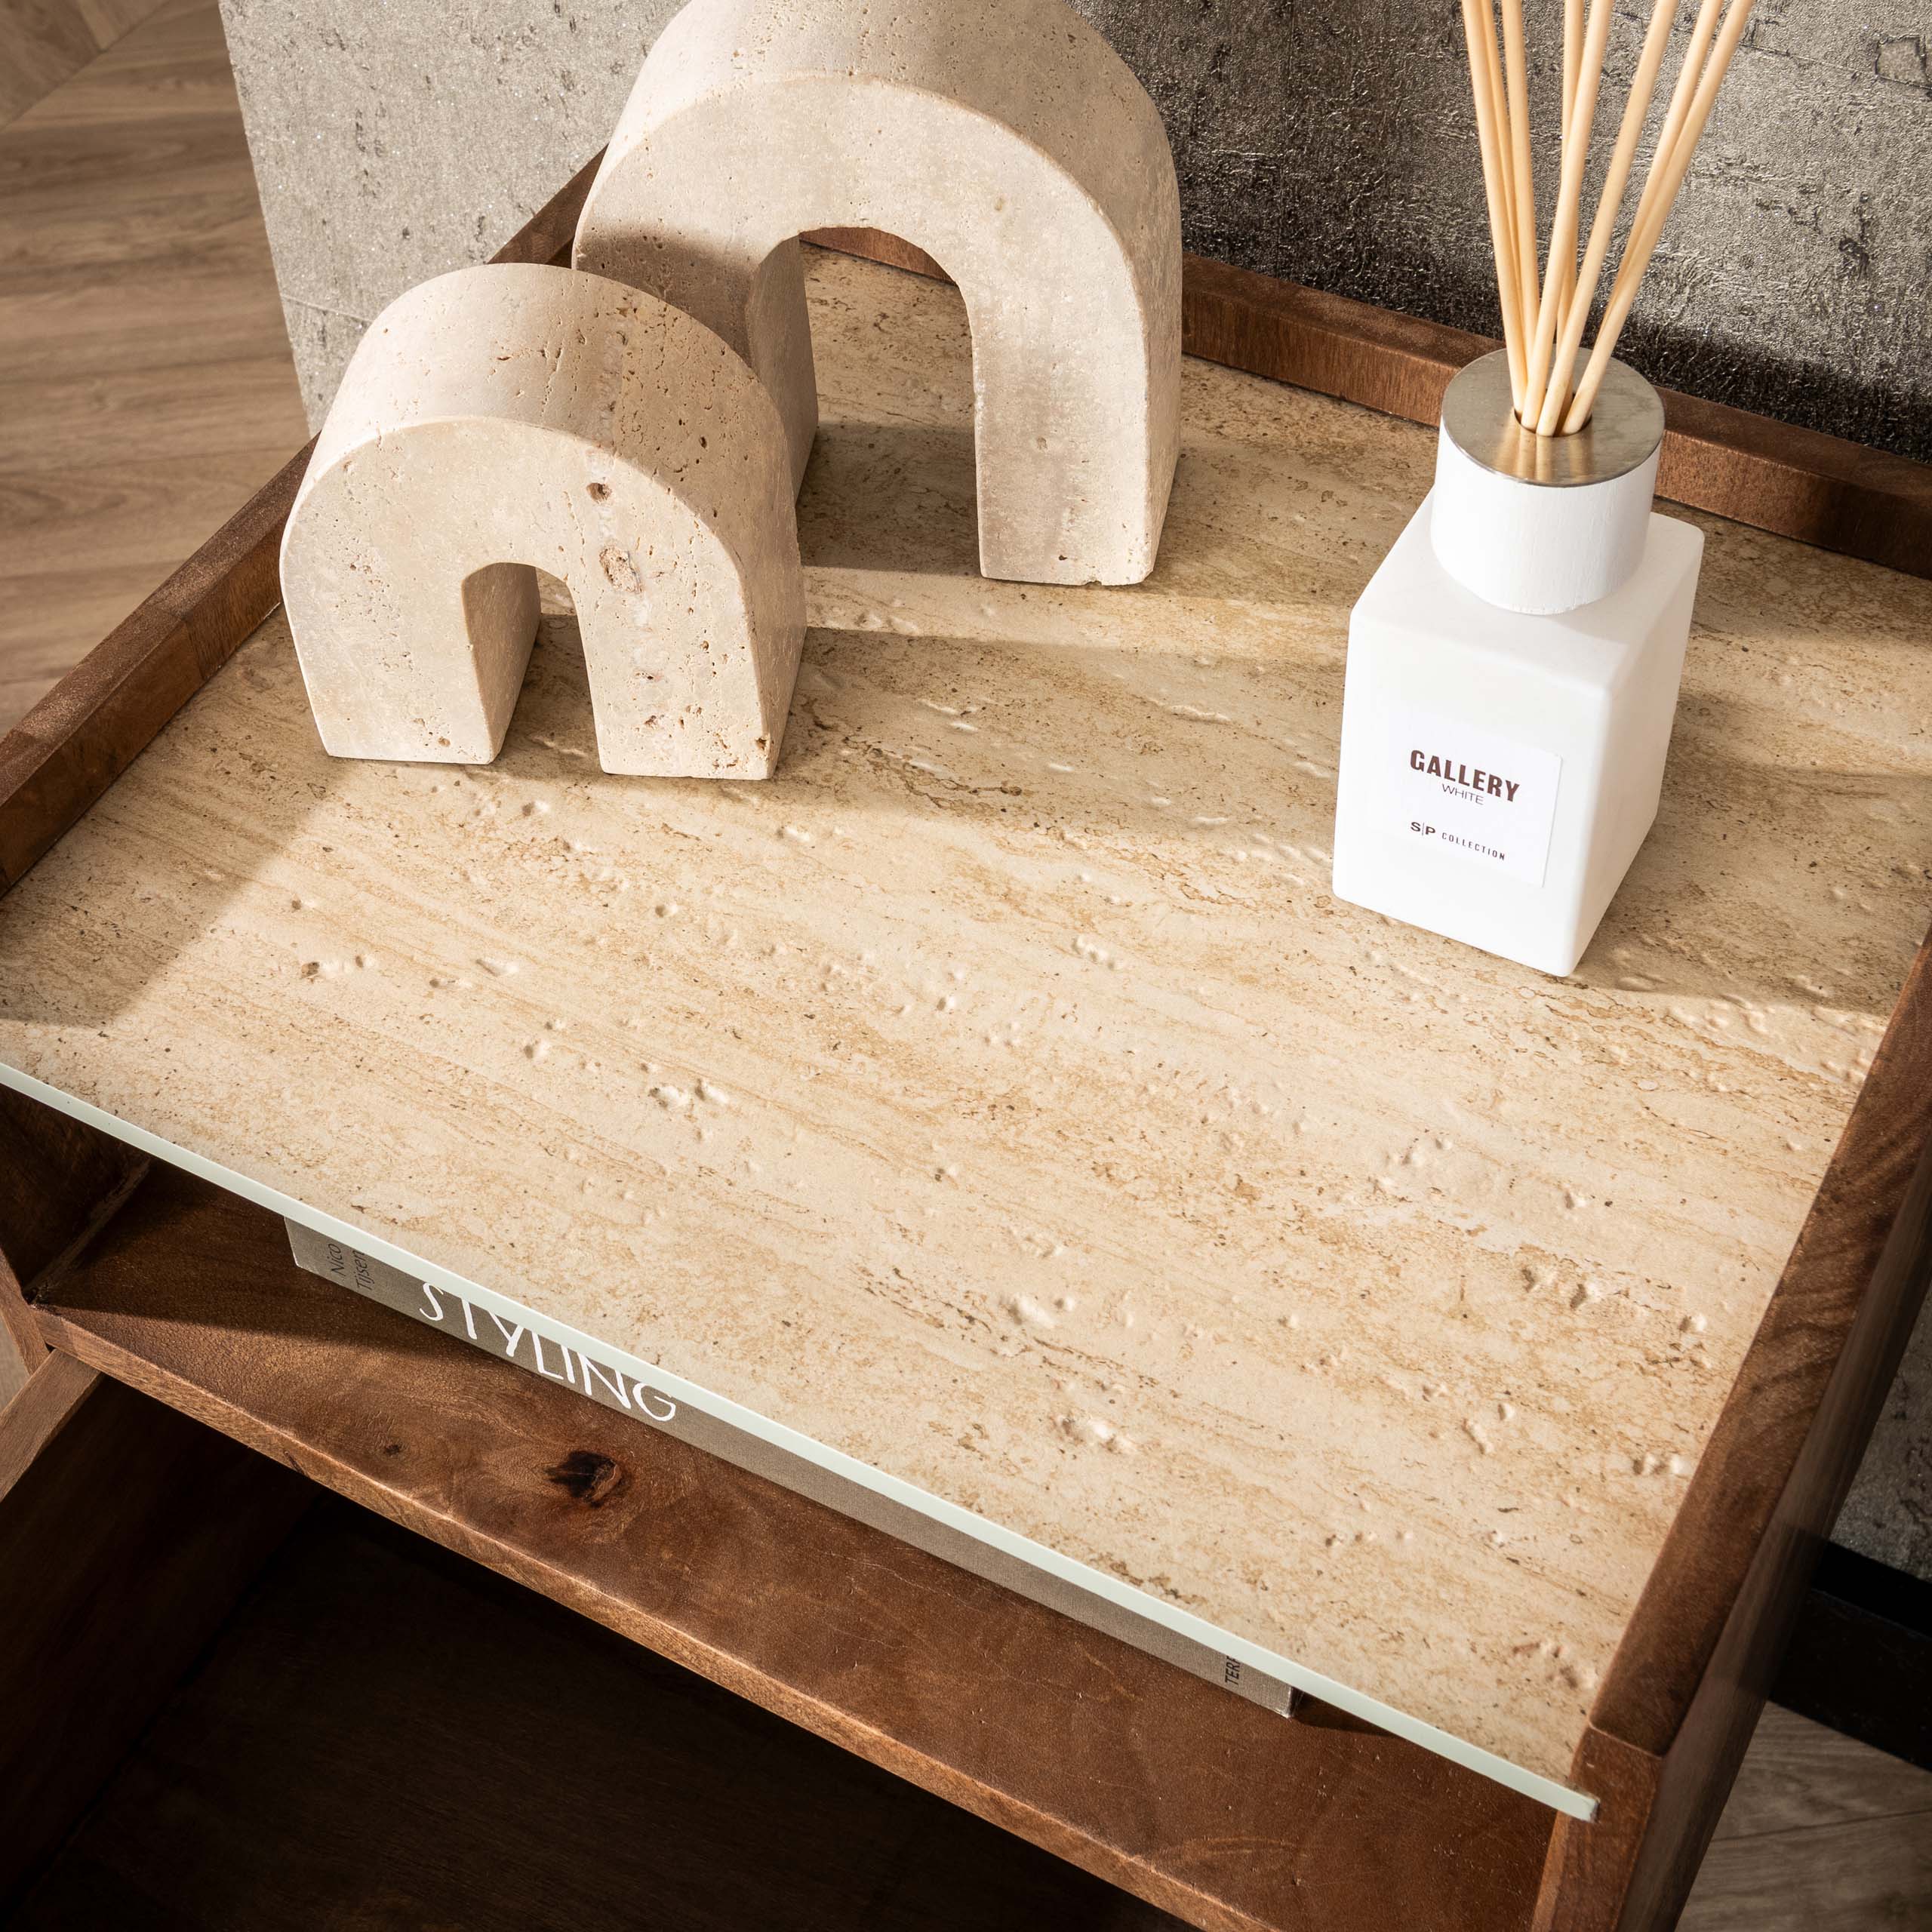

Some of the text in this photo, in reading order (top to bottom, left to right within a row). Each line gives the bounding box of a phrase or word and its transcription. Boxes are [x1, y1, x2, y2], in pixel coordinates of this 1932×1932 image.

[1410, 750, 1520, 802] GALLERY
[1442, 783, 1484, 805] WHITE
[1441, 832, 1506, 860] COLLECTION
[327, 1243, 346, 1277] Nico
[352, 1250, 375, 1291] Tijsen
[419, 1282, 676, 1422] STYLING
